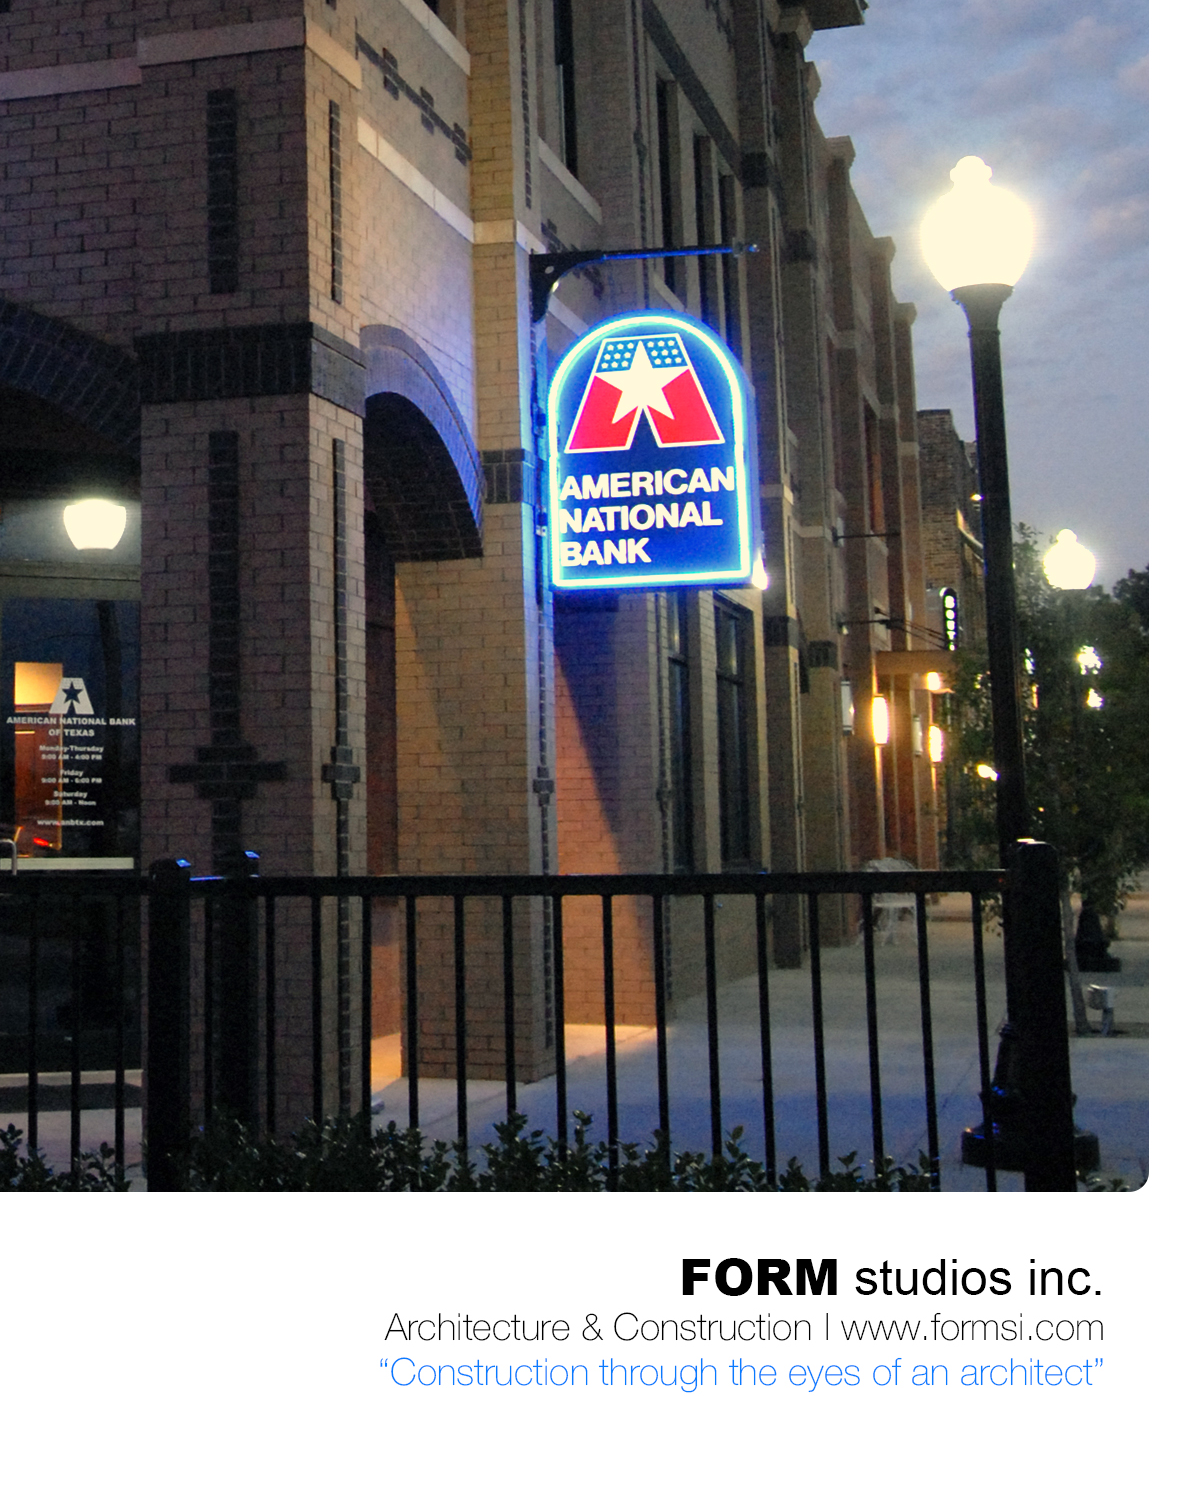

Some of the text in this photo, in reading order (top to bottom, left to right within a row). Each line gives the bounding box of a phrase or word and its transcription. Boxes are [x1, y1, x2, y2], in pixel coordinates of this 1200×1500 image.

[559, 466, 736, 501] AMERICAN
[558, 501, 724, 534] NATIONAL
[559, 537, 652, 568] BANK
[6, 716, 136, 726] AMERICAN NATIONAL BANK
[48, 729, 95, 737] OF TEXAS
[39, 745, 104, 753] Monday-Thursday
[60, 769, 83, 777] Friday
